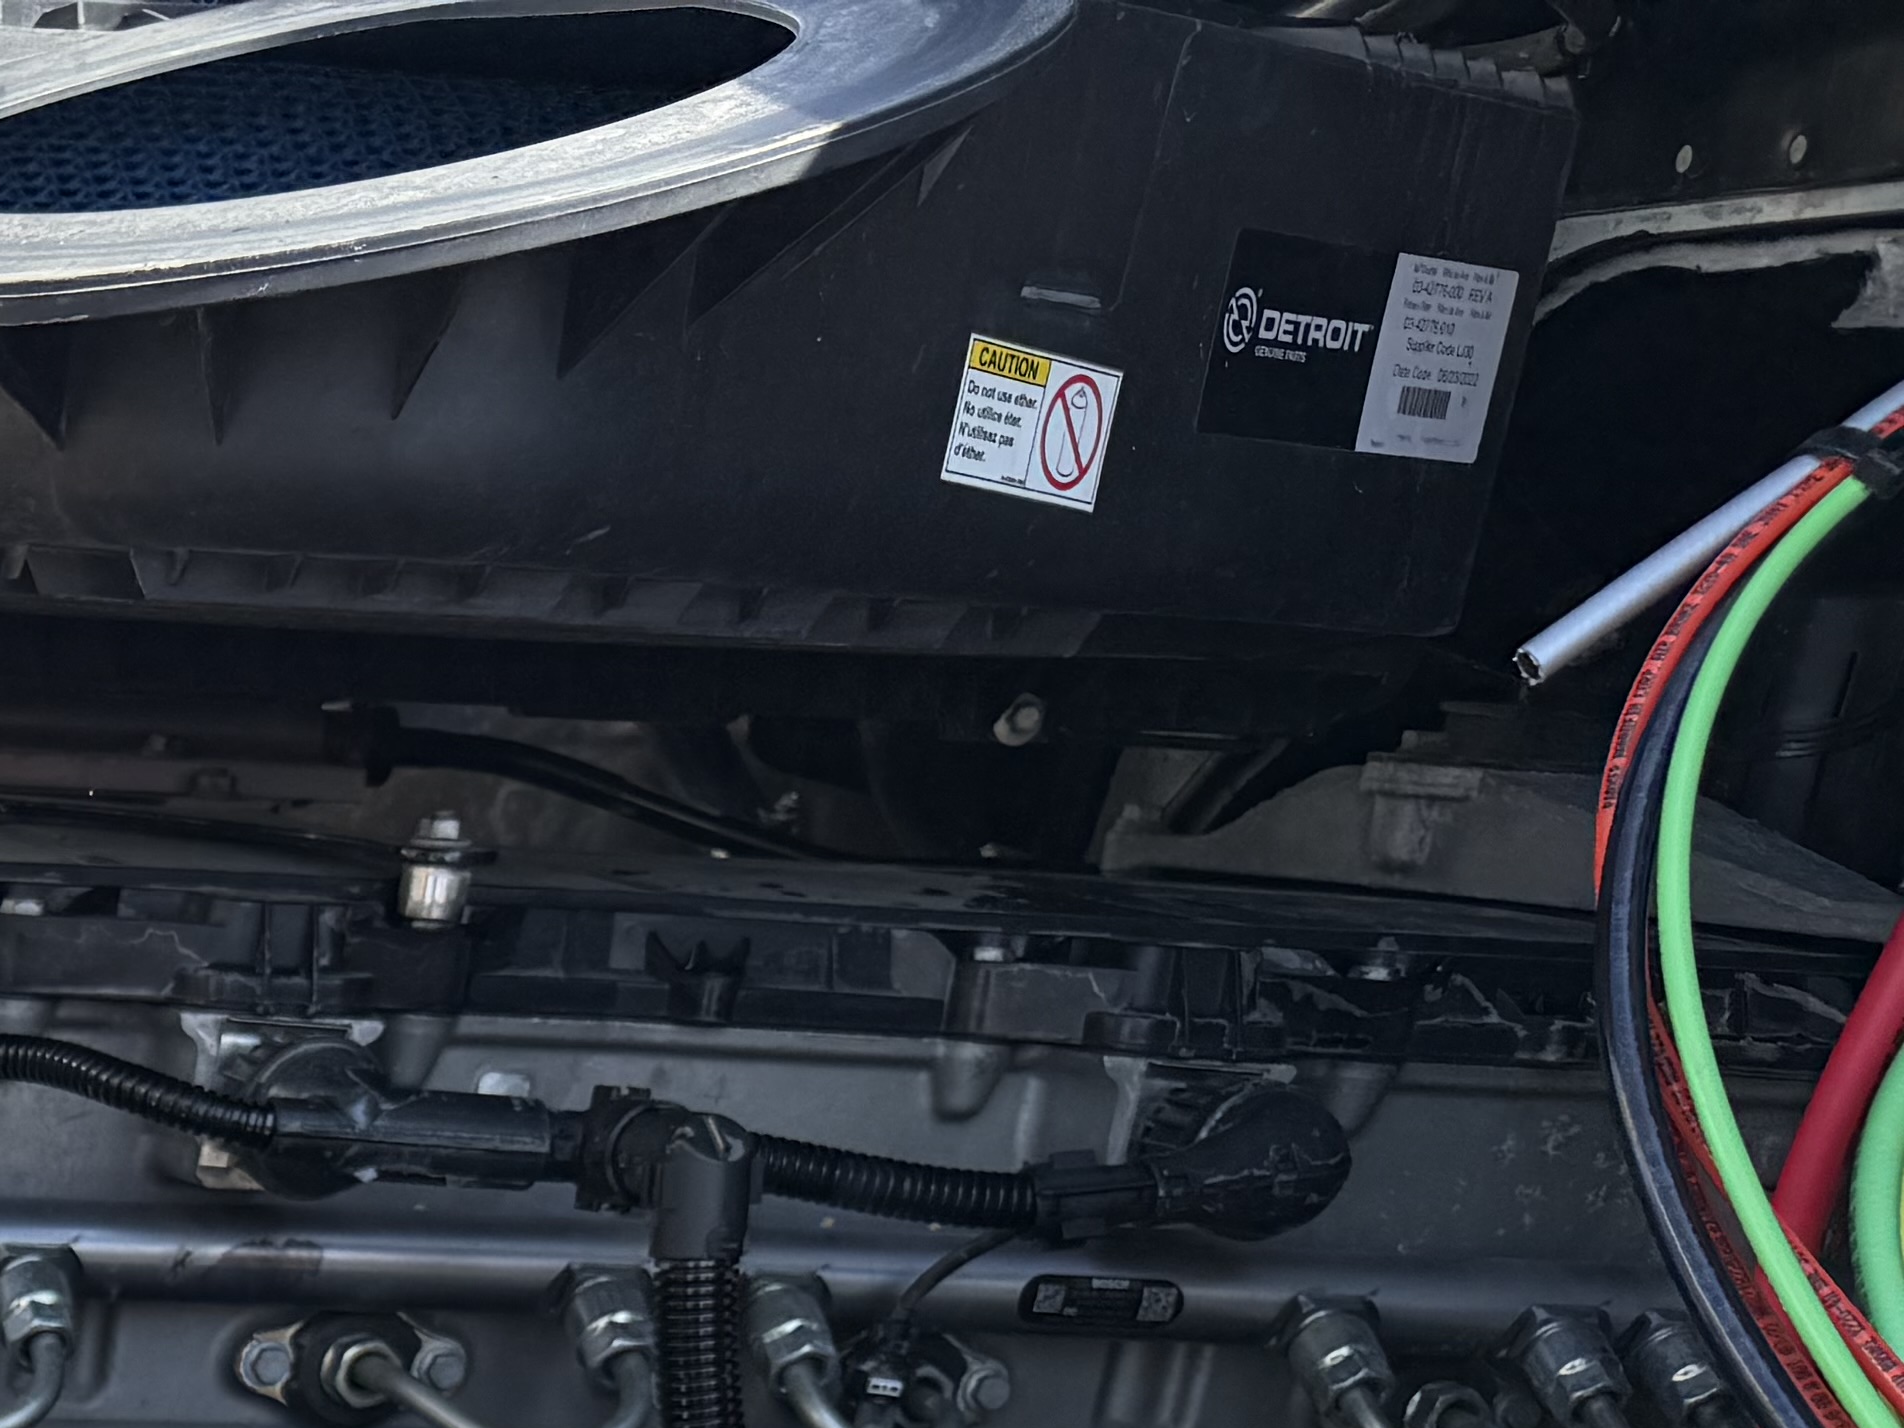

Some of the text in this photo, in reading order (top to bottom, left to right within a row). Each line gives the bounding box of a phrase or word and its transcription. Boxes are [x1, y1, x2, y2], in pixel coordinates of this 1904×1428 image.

[1258, 308, 1372, 353] DETROIT
[1436, 340, 1455, 357] Code
[978, 347, 1040, 380] CAUTION
[967, 380, 980, 396] Do
[980, 386, 996, 402] not
[997, 391, 1013, 404] use
[962, 401, 976, 416] No
[998, 433, 1015, 449] pas
